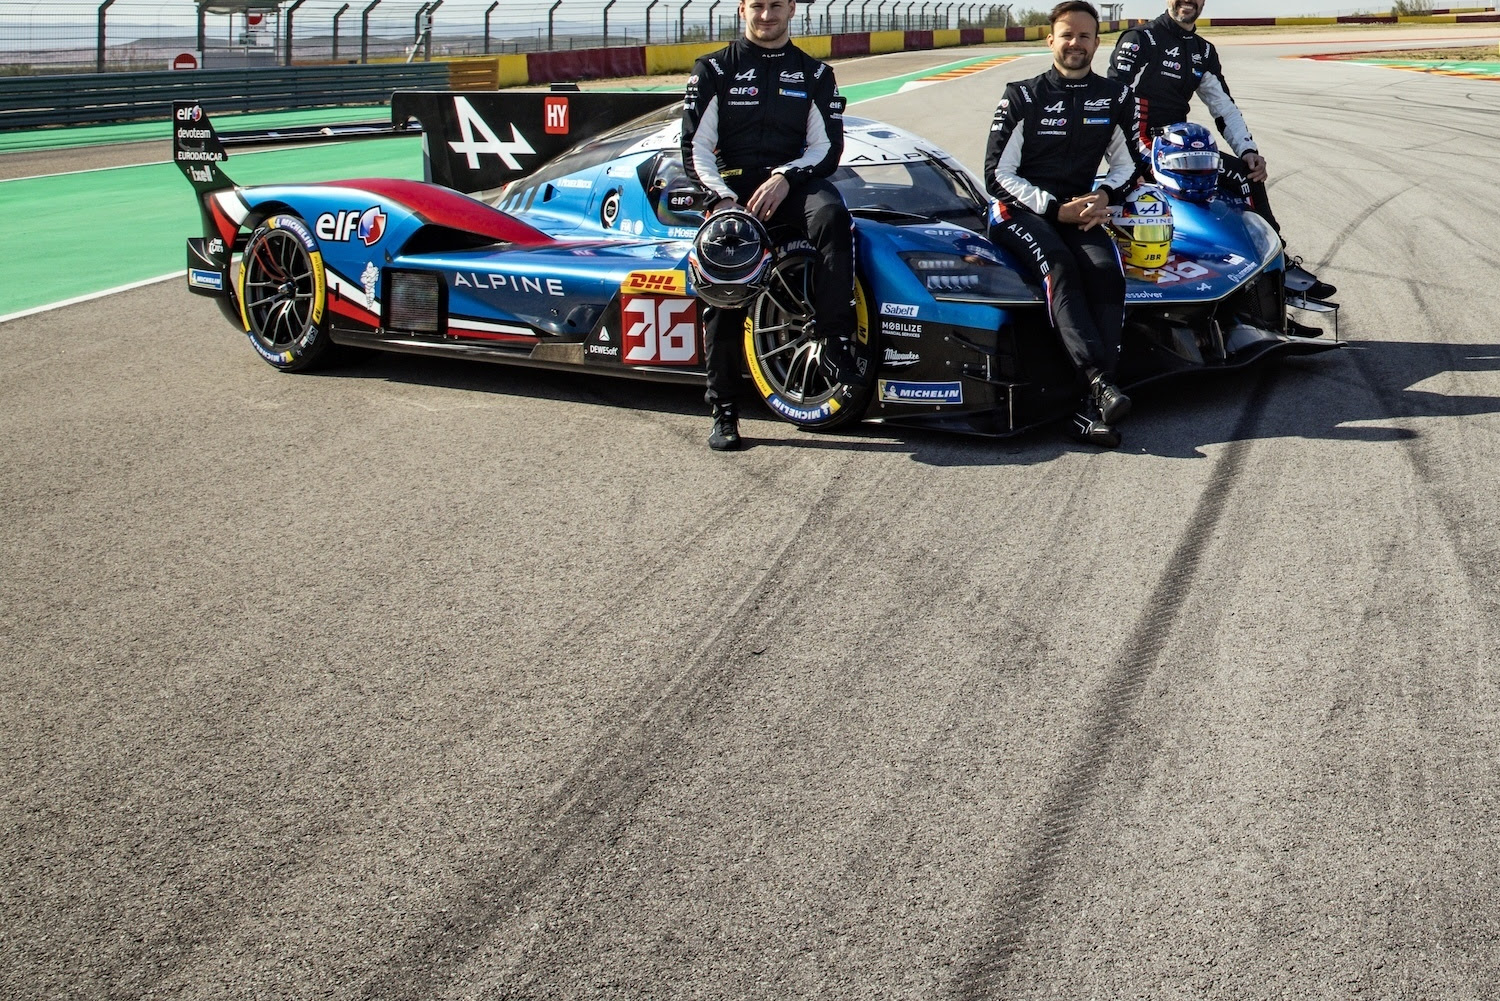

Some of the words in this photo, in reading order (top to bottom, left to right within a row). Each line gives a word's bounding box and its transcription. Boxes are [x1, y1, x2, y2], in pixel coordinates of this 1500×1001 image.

[546, 103, 567, 129] HY
[1040, 118, 1057, 126] elf
[178, 127, 211, 139] devoteam
[178, 151, 223, 161] EURODATACAR
[315, 210, 360, 242] elf
[1128, 217, 1173, 225] ALPINE
[281, 218, 314, 248] MICHELIN
[1007, 223, 1050, 275] ALPINE
[1144, 253, 1162, 261] JBR
[453, 271, 565, 297] ALPINE
[629, 273, 677, 291] DHL
[1125, 289, 1163, 299] essolver
[885, 304, 915, 316] Sabelt
[624, 298, 696, 361] 36
[250, 335, 280, 362] MICHELIN
[884, 347, 920, 361] Milwaukee
[900, 388, 960, 398] MICHELIN
[772, 398, 821, 420] MICHELIN
